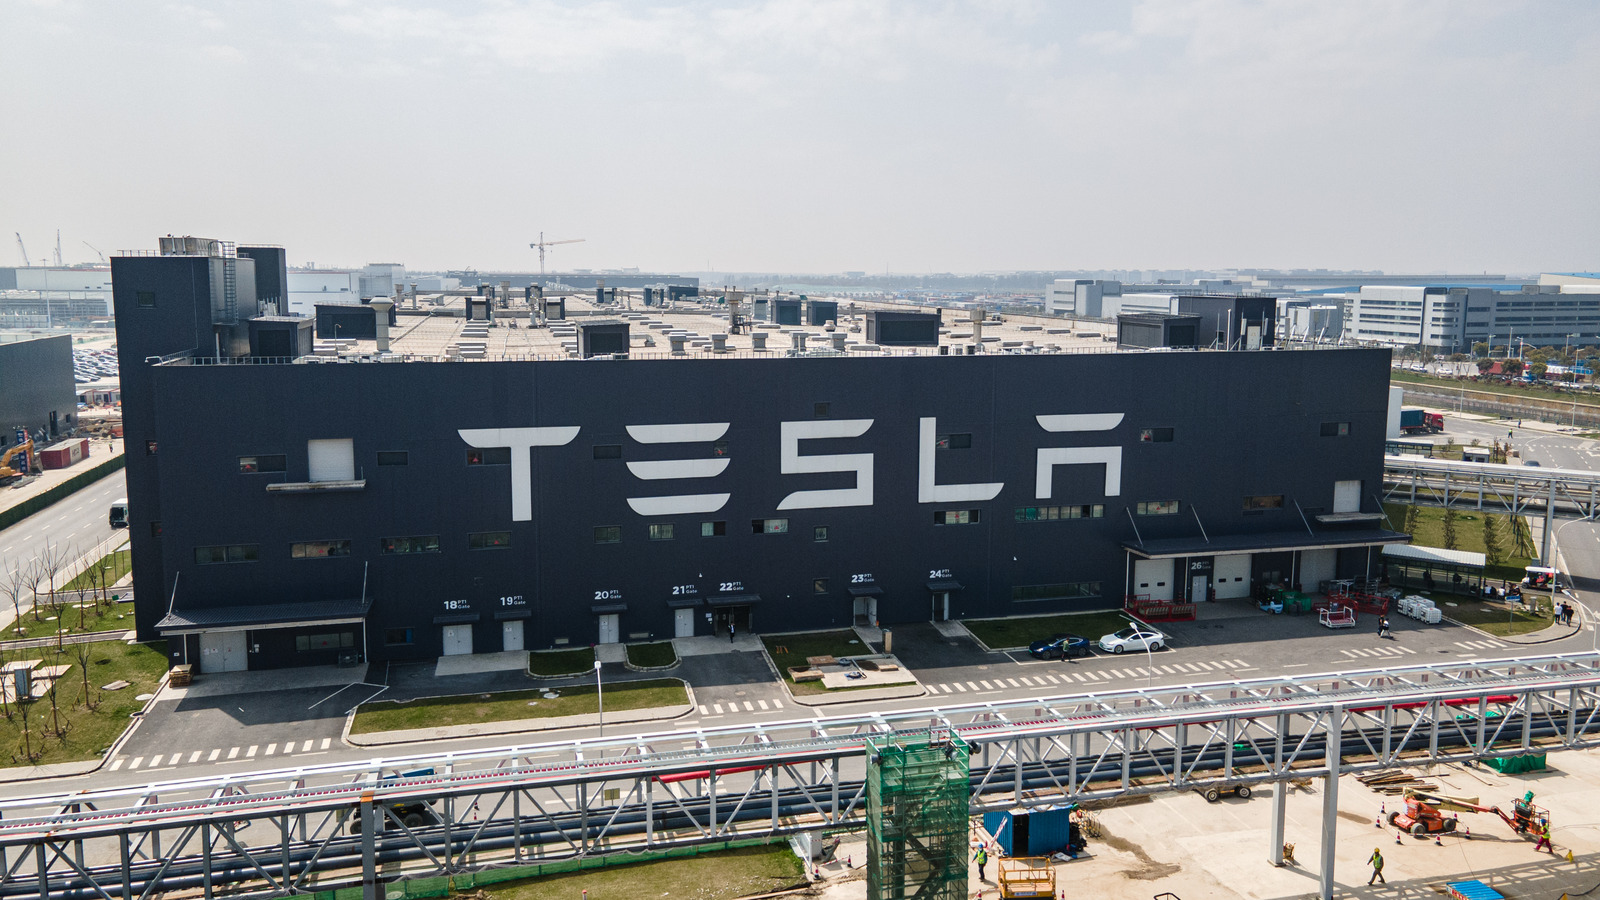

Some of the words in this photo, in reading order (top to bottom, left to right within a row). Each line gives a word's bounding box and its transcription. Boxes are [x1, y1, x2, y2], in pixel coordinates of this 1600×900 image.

[458, 412, 1125, 521] TESLA
[1191, 561, 1202, 570] 26
[851, 574, 864, 583] 23
[929, 569, 942, 579] 24
[672, 585, 685, 595] 21
[719, 582, 733, 591] 22
[594, 590, 609, 600] 20
[444, 600, 458, 610] 18
[500, 596, 513, 606] 19
